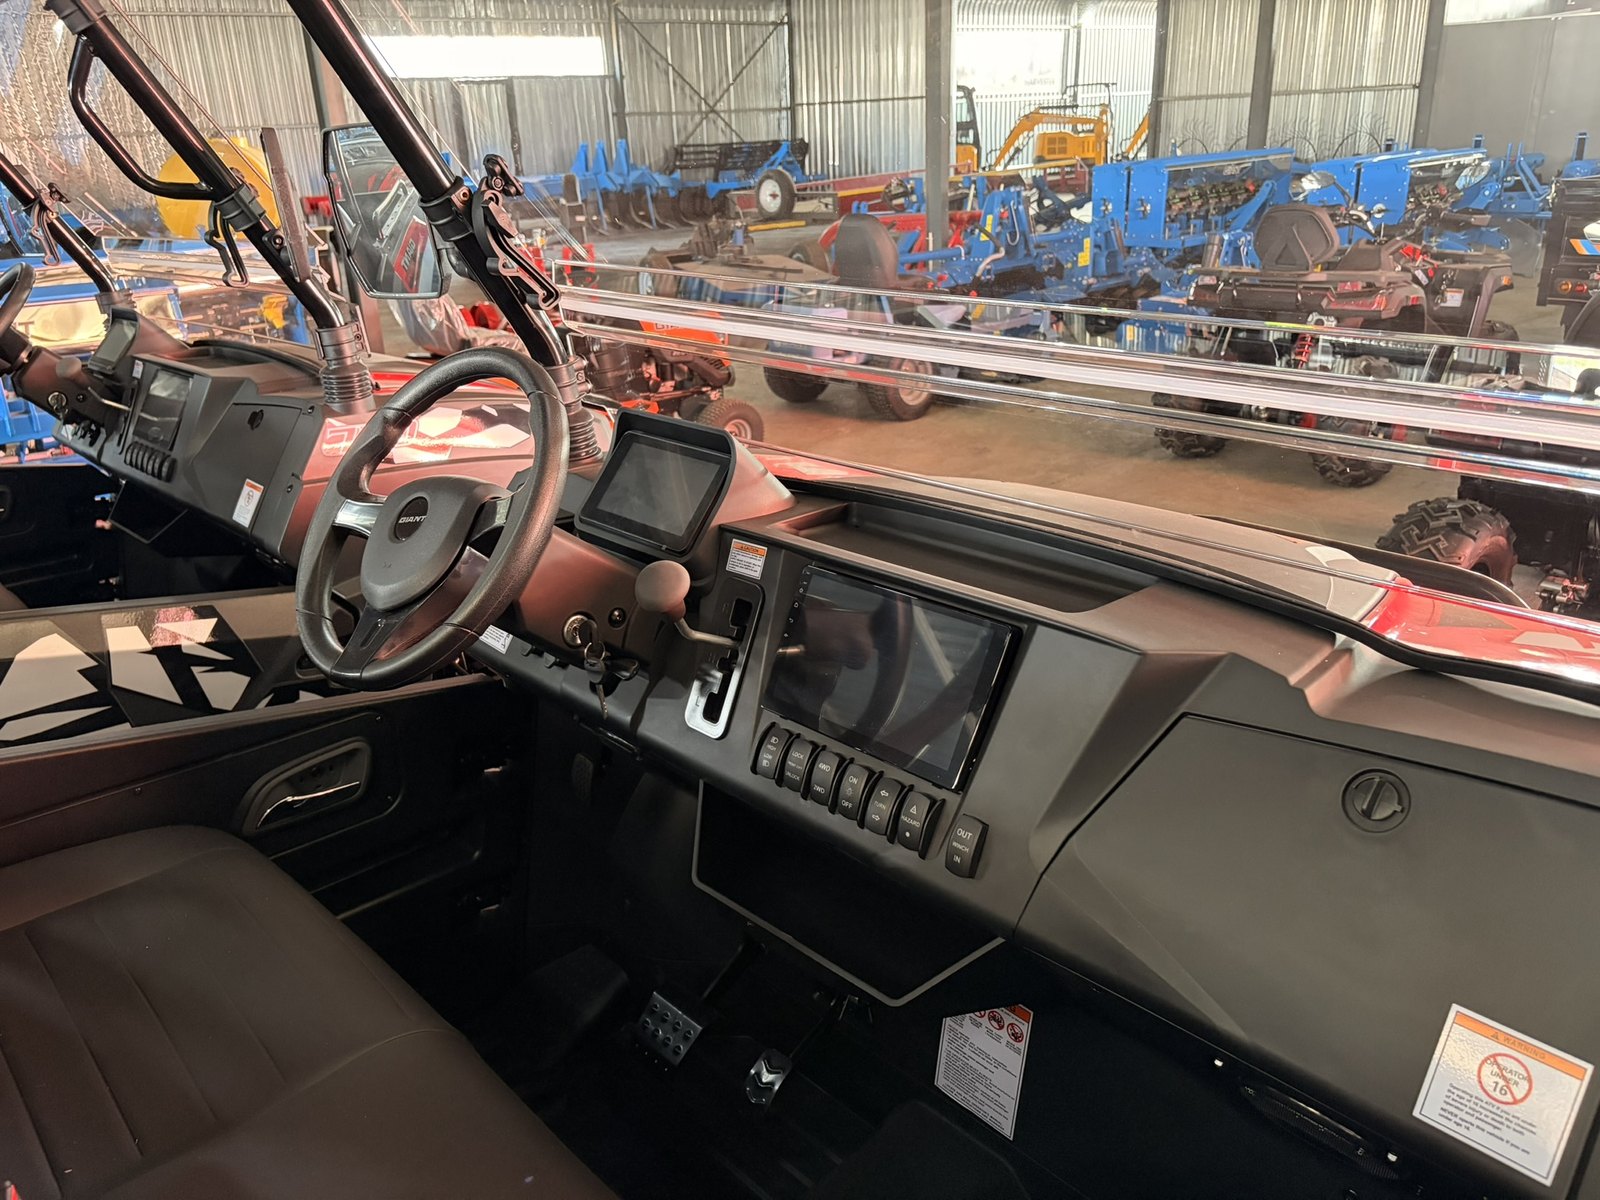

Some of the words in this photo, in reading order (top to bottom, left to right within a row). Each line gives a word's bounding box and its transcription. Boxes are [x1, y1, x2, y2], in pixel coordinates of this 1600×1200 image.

[398, 515, 428, 524] GIANT
[763, 752, 773, 760] LOW
[791, 751, 804, 759] LOCK
[818, 762, 831, 772] 4WD
[848, 775, 858, 785] ON
[813, 784, 825, 794] 2WD
[841, 800, 853, 809] OFF
[901, 815, 921, 828] HAZARD
[957, 828, 973, 840] OUT
[952, 841, 970, 853] WINCH
[953, 855, 961, 863] IN
[1503, 1036, 1546, 1060] WARNING
[1490, 1069, 1520, 1087] UNDER
[1492, 1080, 1508, 1096] 16
